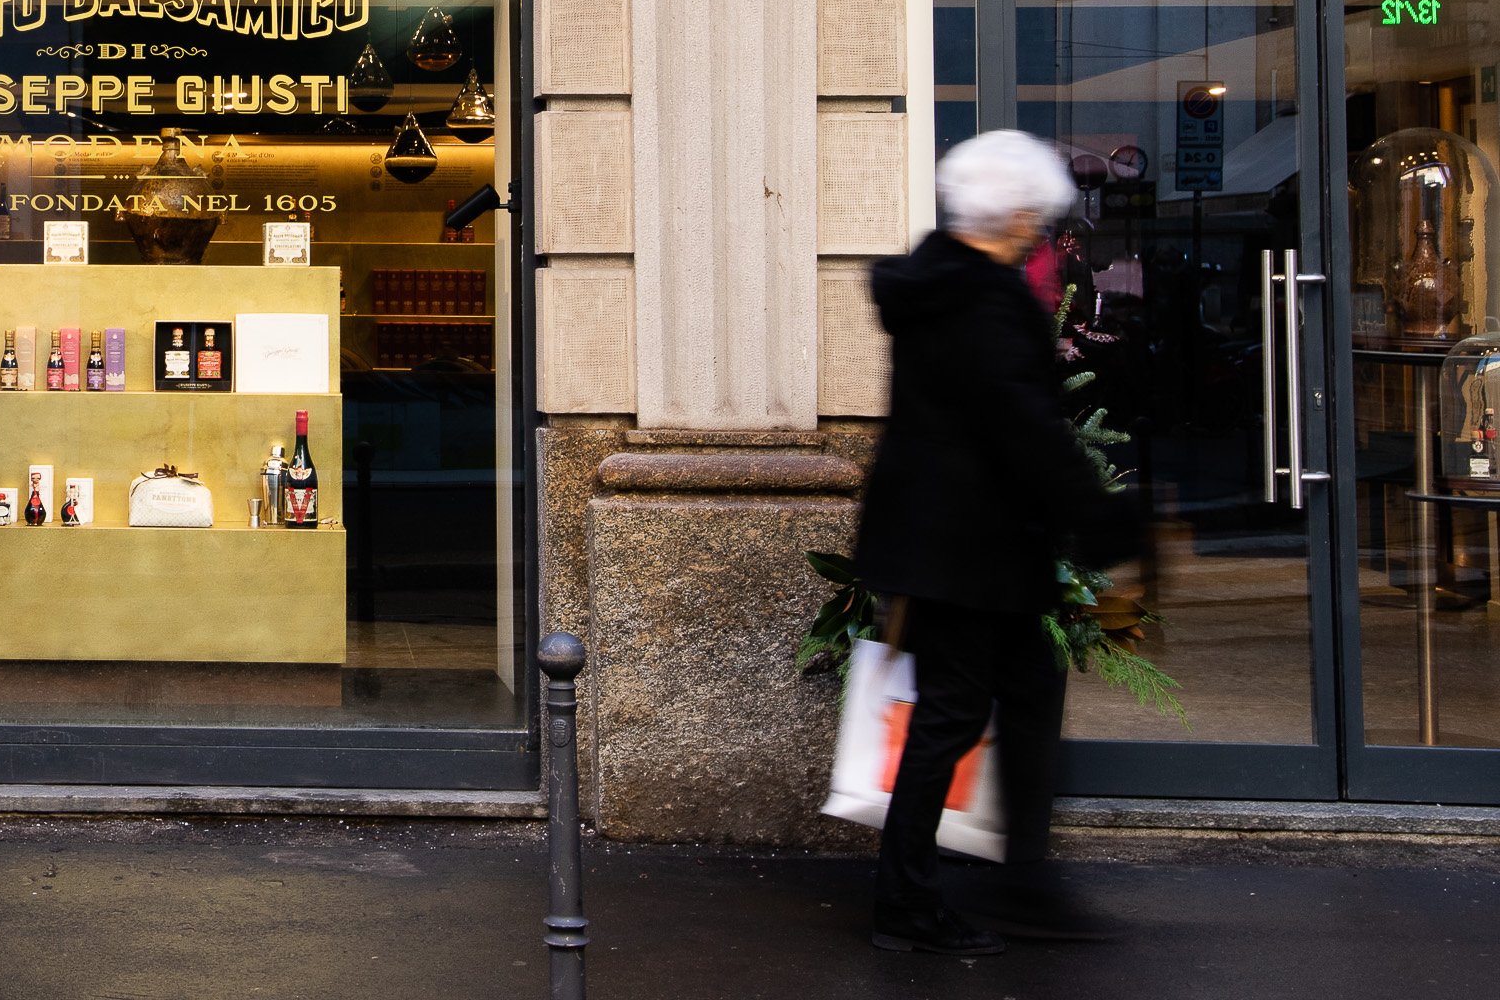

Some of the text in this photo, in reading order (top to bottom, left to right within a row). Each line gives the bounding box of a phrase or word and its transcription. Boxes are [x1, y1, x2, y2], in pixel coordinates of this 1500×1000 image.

[97, 43, 147, 61] DI
[175, 74, 349, 116] GIUSTI
[10, 194, 168, 212] FONDATA
[181, 194, 250, 212] NEL
[263, 194, 337, 212] 1605
